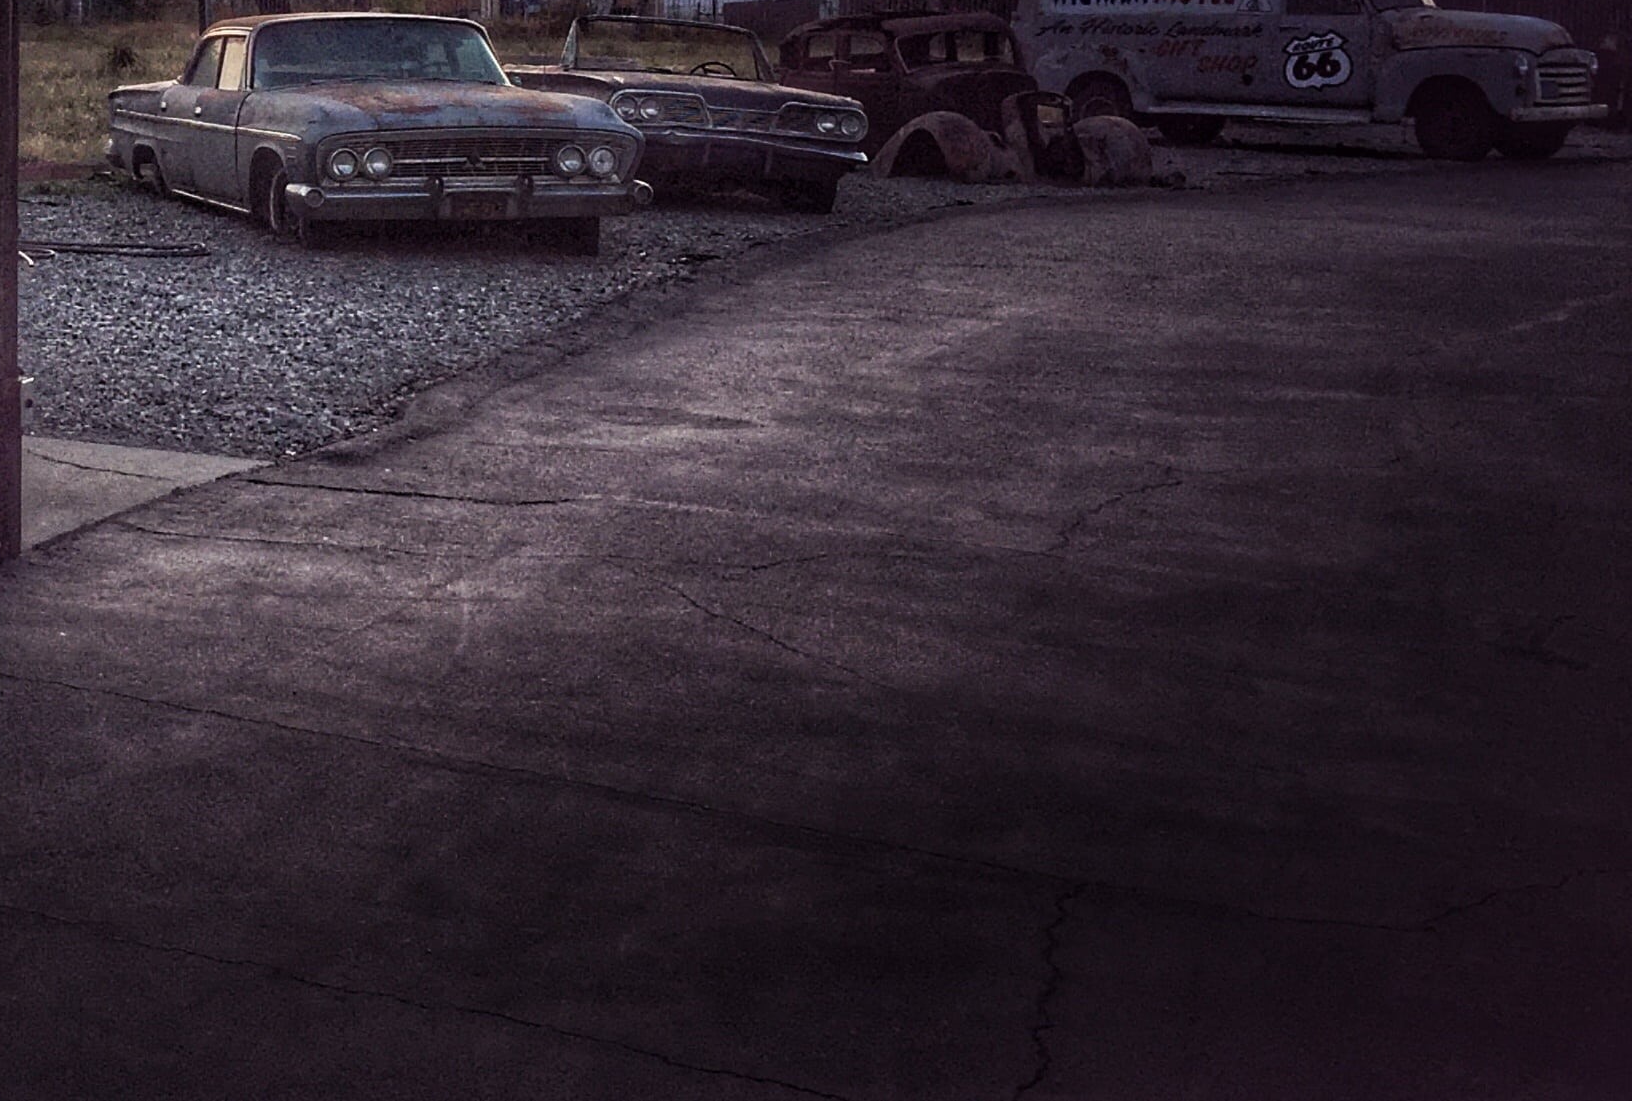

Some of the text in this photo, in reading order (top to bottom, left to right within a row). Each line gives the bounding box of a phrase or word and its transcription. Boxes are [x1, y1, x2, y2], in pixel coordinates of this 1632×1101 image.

[1079, 17, 1159, 36] Historic
[1164, 20, 1264, 39] Landmark
[1154, 38, 1207, 57] GIFT
[1291, 37, 1335, 52] ROUTE
[1196, 55, 1258, 73] SHOP
[1292, 50, 1341, 80] 66
